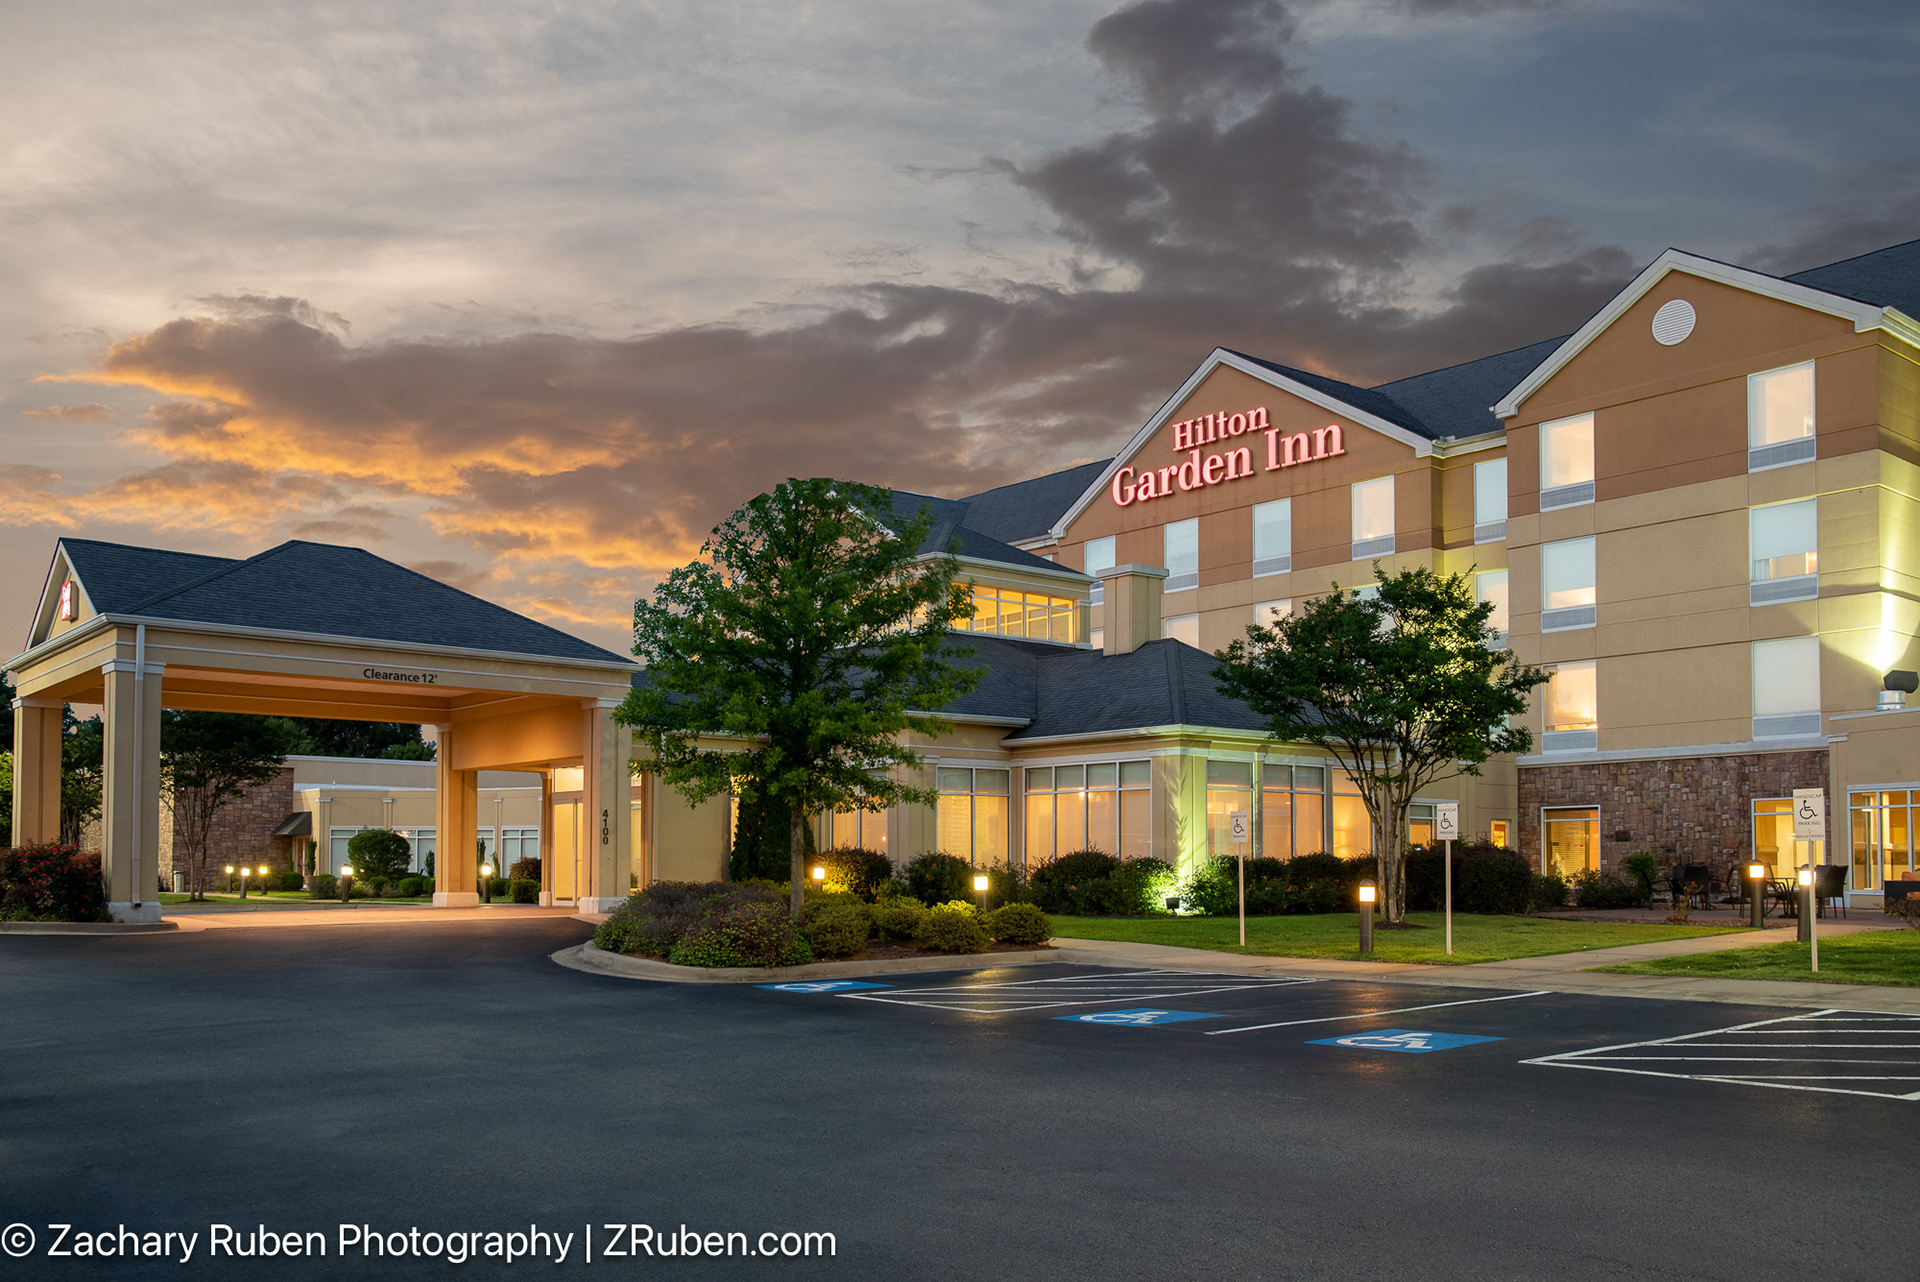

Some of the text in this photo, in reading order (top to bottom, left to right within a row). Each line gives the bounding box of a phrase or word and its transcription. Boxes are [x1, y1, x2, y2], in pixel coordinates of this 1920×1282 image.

[1172, 405, 1269, 452] Hilton
[1112, 423, 1345, 507] Garden Inn
[363, 668, 438, 684] Clearance 12'
